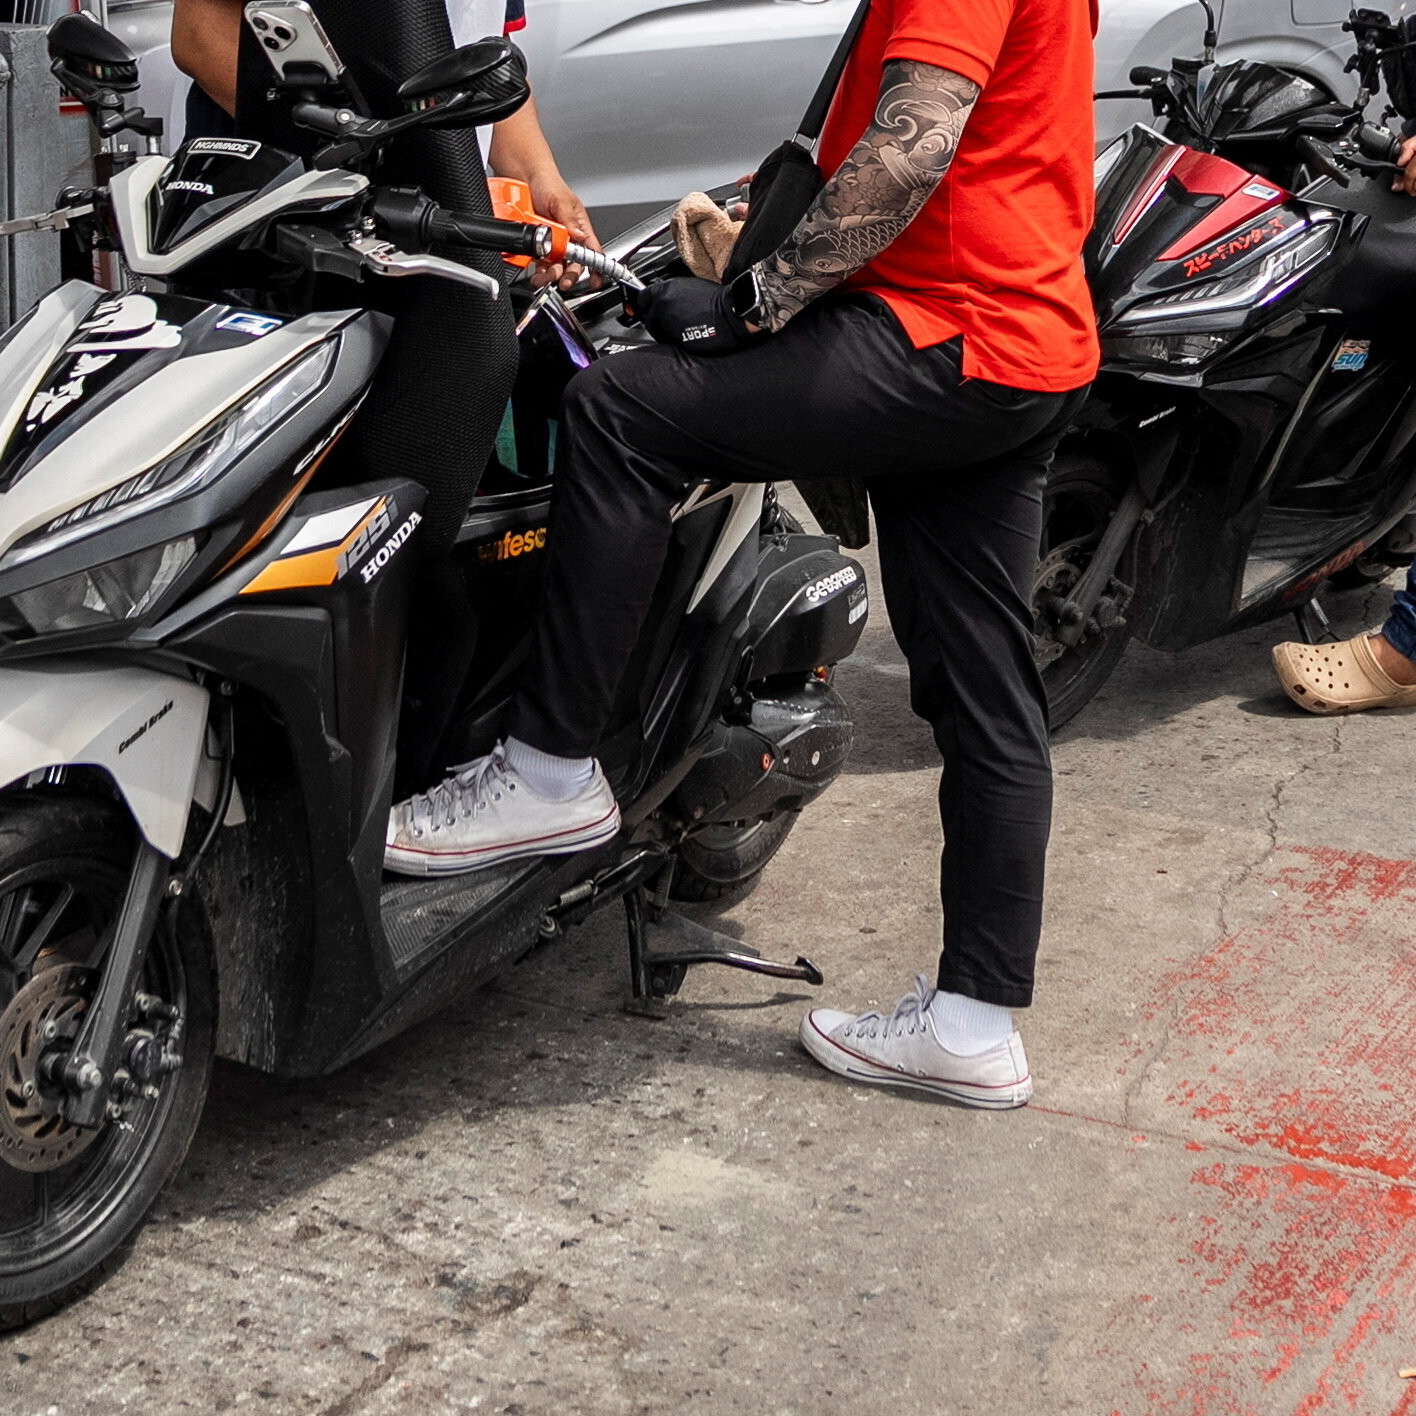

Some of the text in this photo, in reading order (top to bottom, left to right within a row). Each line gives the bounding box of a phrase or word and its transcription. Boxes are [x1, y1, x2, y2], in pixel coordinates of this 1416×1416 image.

[165, 180, 214, 195] HONDA
[359, 510, 423, 584] HONDA
[119, 721, 148, 754] Combi
